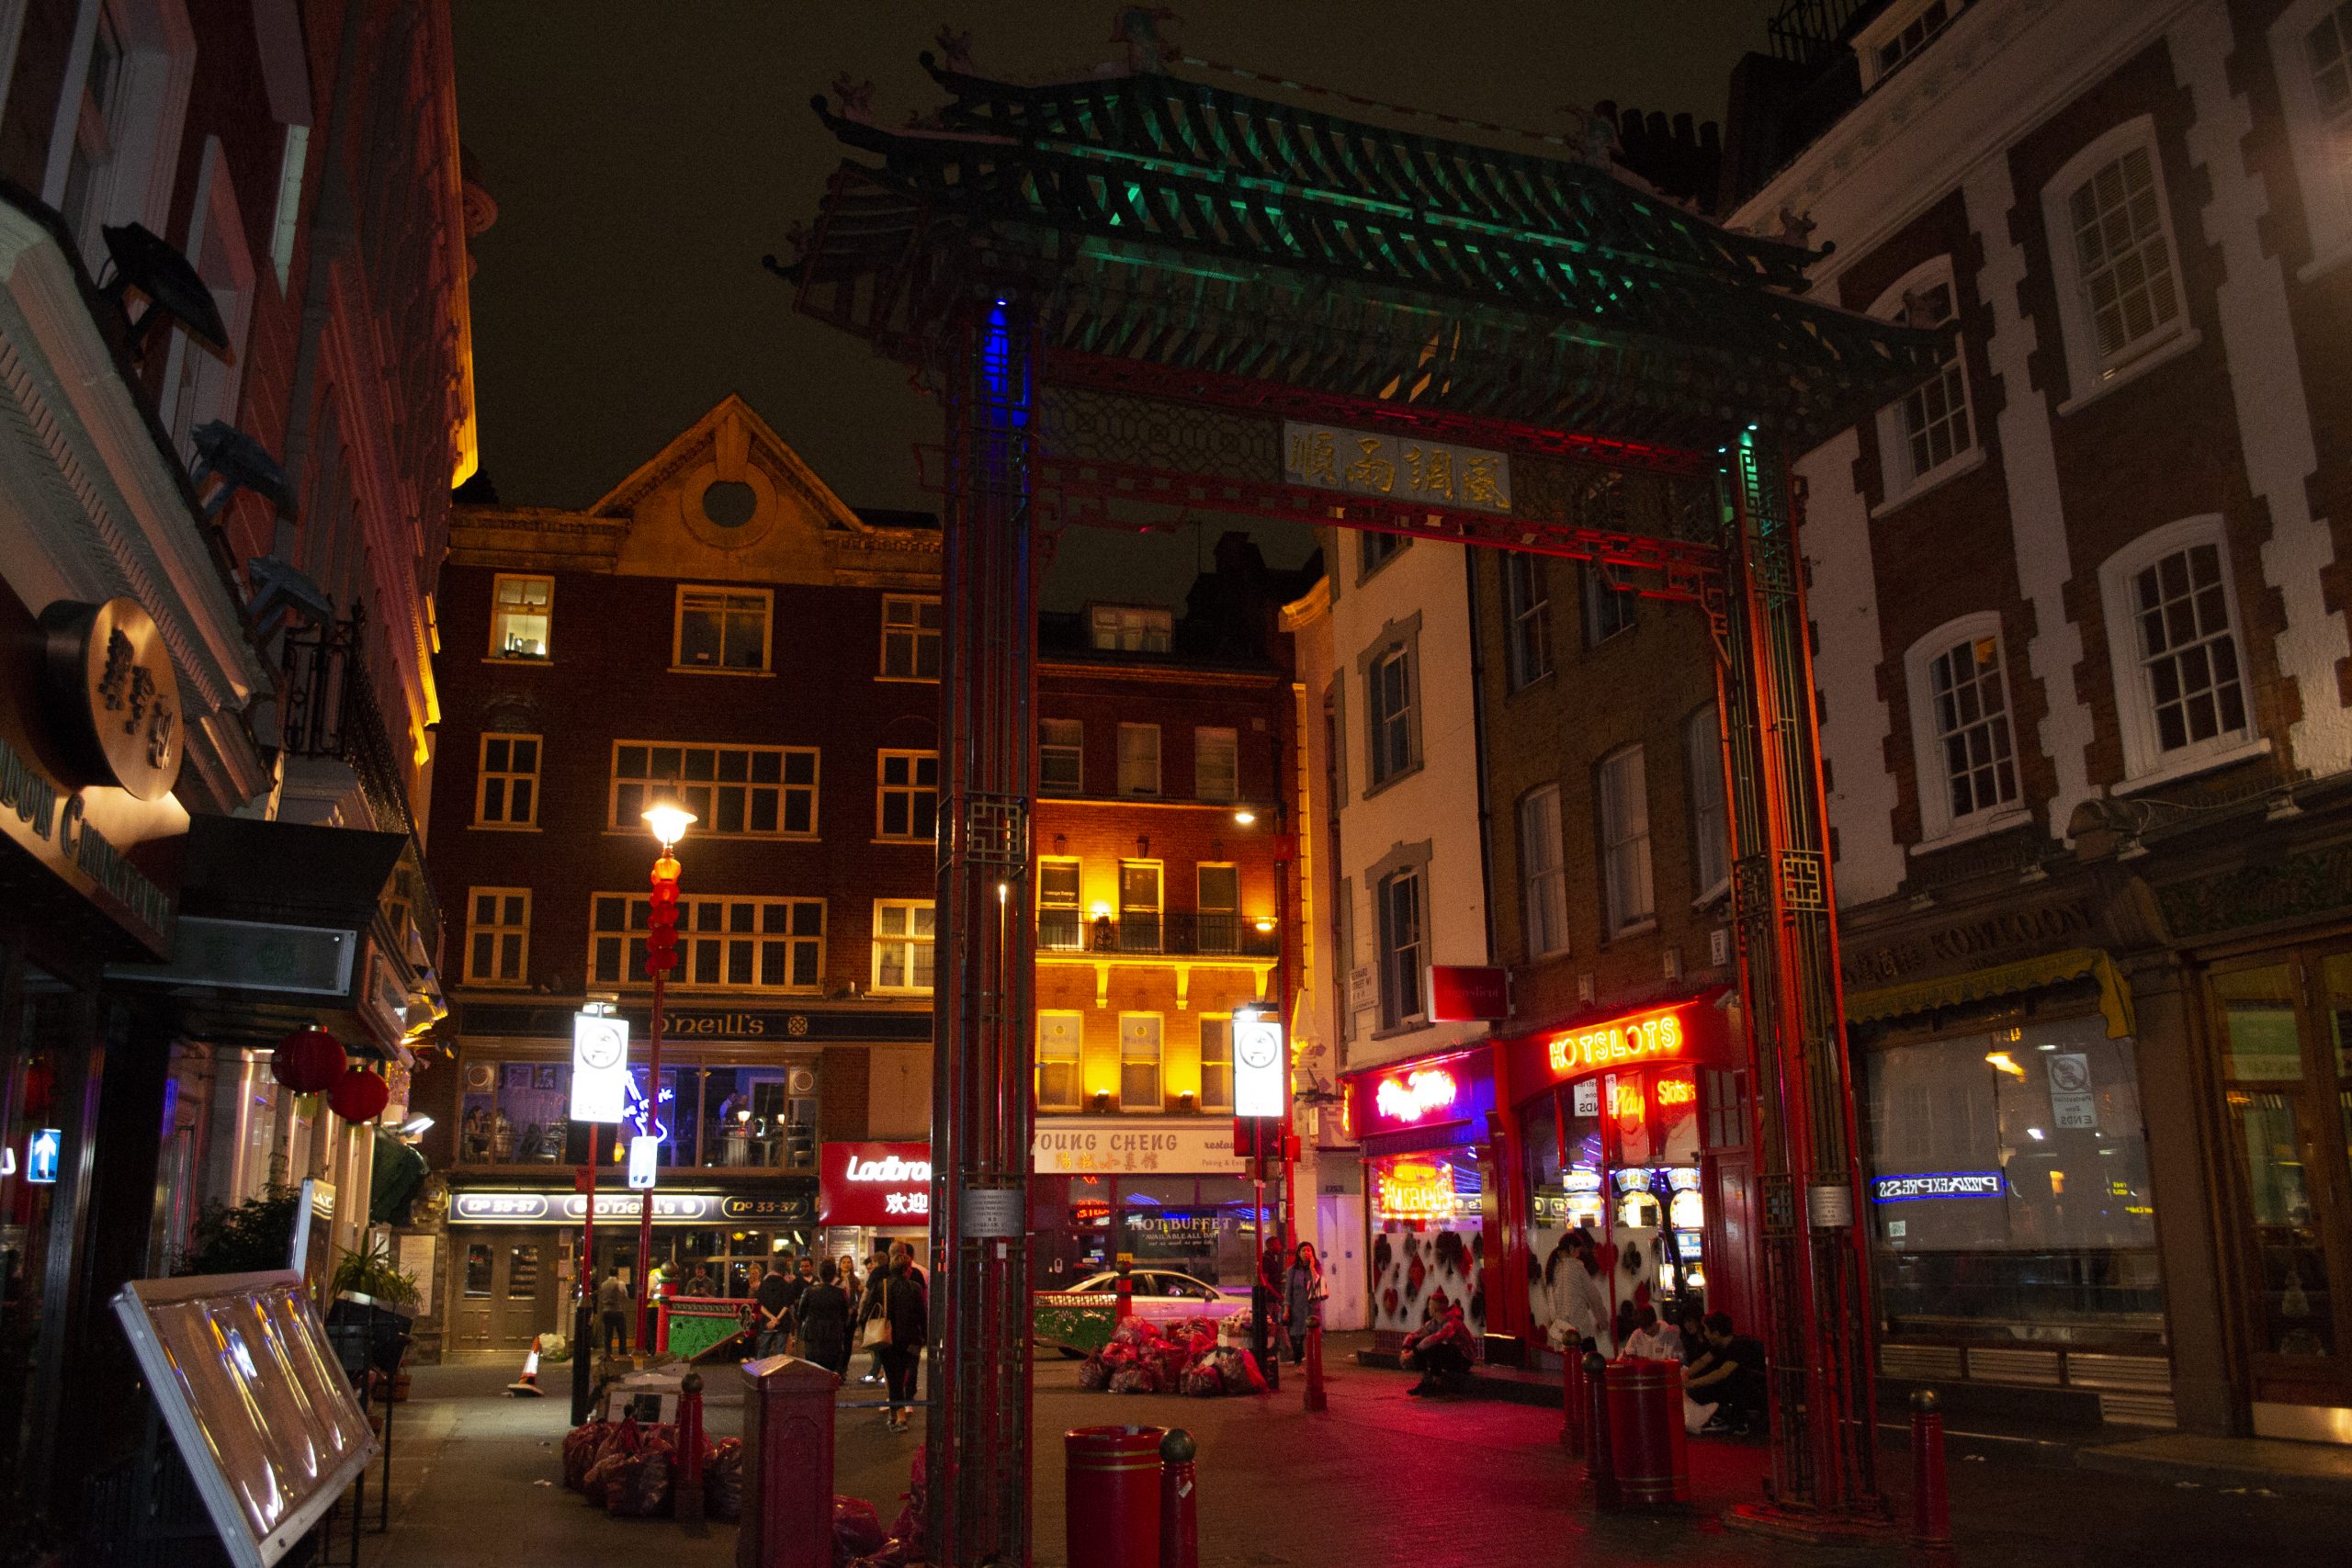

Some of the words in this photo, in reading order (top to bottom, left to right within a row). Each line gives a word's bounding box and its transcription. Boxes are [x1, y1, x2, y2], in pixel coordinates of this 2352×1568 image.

[1035, 1133, 1097, 1151] OUNG
[1110, 1134, 1178, 1152] CHENG
[1130, 1218, 1165, 1231] HOT
[1171, 1217, 1232, 1231] BUFFET
